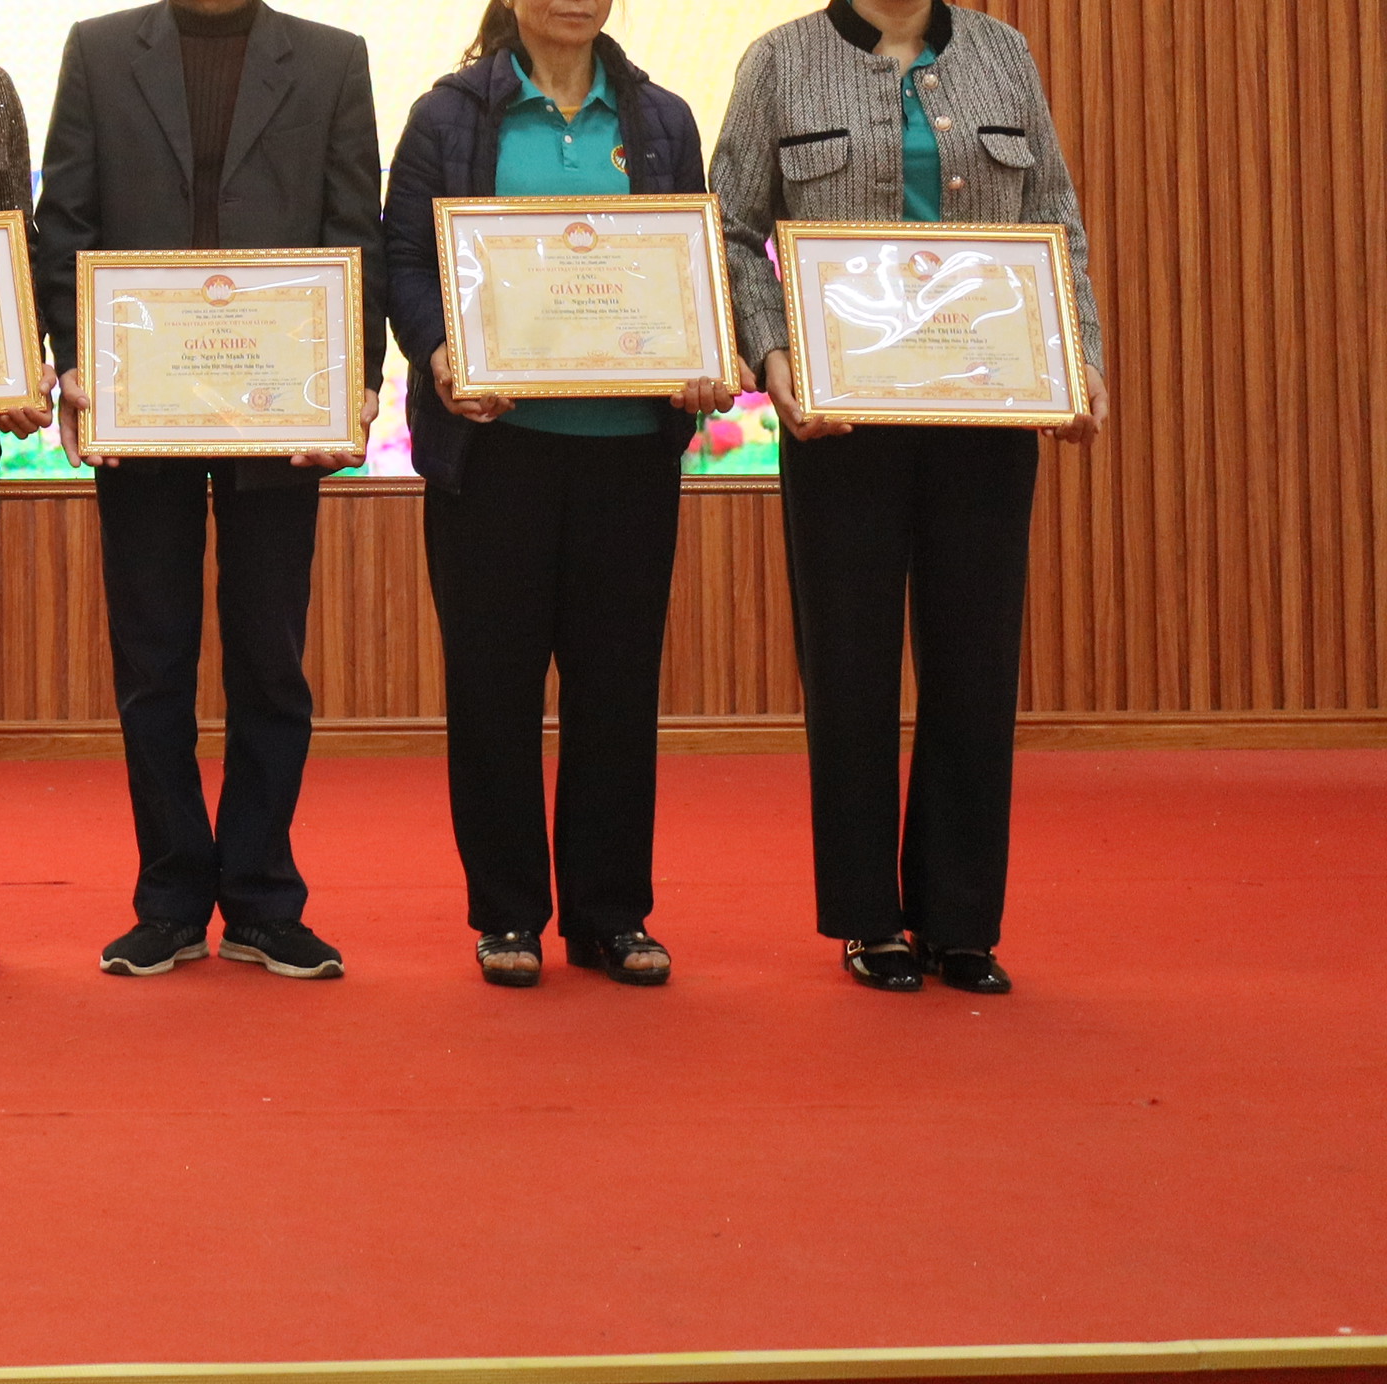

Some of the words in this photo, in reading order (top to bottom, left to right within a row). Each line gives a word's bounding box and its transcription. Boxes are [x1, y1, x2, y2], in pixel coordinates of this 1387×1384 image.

[587, 283, 623, 294] KHEN
[932, 312, 970, 323] KHEN
[220, 337, 257, 349] KHEN
[201, 352, 224, 361] Nguyễn
